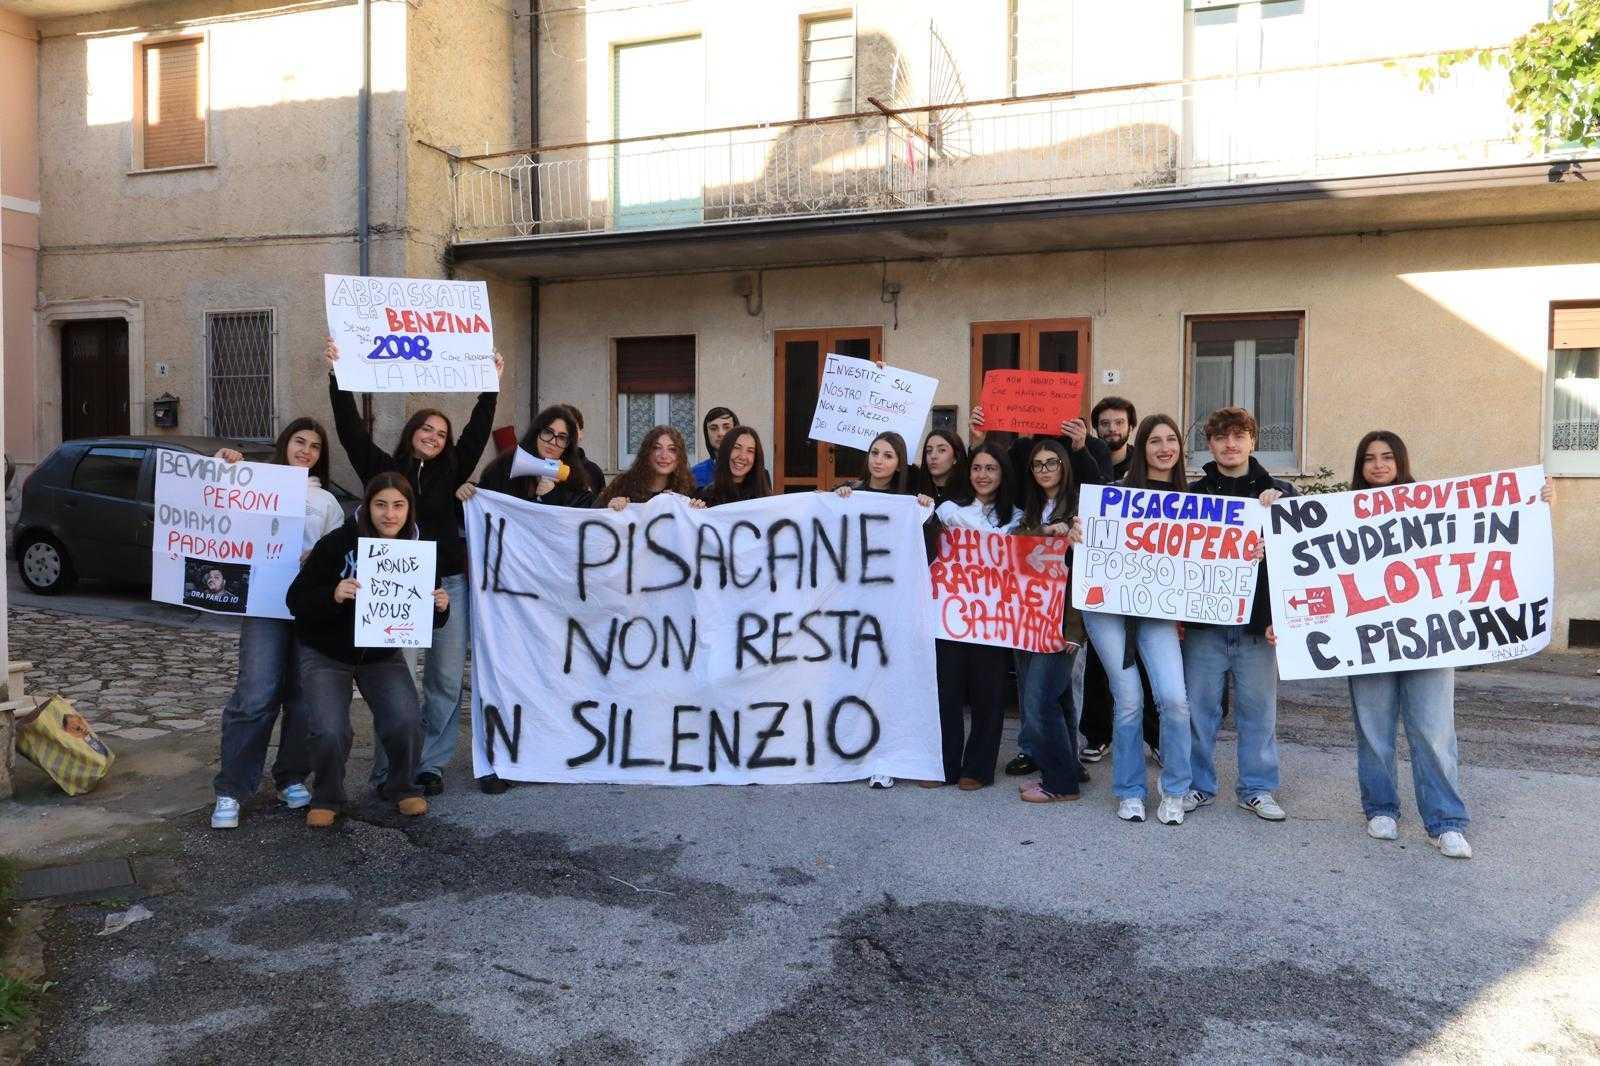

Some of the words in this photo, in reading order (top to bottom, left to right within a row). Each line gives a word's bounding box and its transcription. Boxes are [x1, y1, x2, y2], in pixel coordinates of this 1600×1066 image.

[331, 278, 482, 310] ABBASSATE
[385, 307, 490, 334] BENZINA
[367, 334, 433, 361] 2008
[374, 362, 405, 389] LA
[413, 363, 492, 390] PATENTE
[822, 382, 862, 400] NOSTRO
[826, 357, 885, 383] INVESTITE
[891, 378, 913, 393] SUL
[819, 399, 835, 411] NON
[856, 407, 890, 423] PREZZO
[159, 451, 254, 488] BEVIAMO
[203, 485, 279, 512] PERONI
[1099, 486, 1246, 526] PISACANE
[158, 504, 232, 535] ODIAMO
[1270, 499, 1328, 535] NO
[368, 543, 391, 559] LE
[1086, 516, 1119, 550] IN
[1124, 520, 1260, 562] SCIOPERO
[376, 556, 420, 574] MONDE
[481, 512, 539, 599] IL
[577, 512, 894, 601] PISACANE
[1084, 548, 1175, 586] POSSO
[370, 577, 404, 597] EST
[407, 585, 423, 600] A
[1120, 583, 1152, 615] IO
[1337, 550, 1520, 618] LOTTA
[563, 614, 696, 676] NON
[735, 609, 889, 670] RESTA
[1305, 630, 1355, 671] C.
[567, 694, 882, 773] SILENZIO
